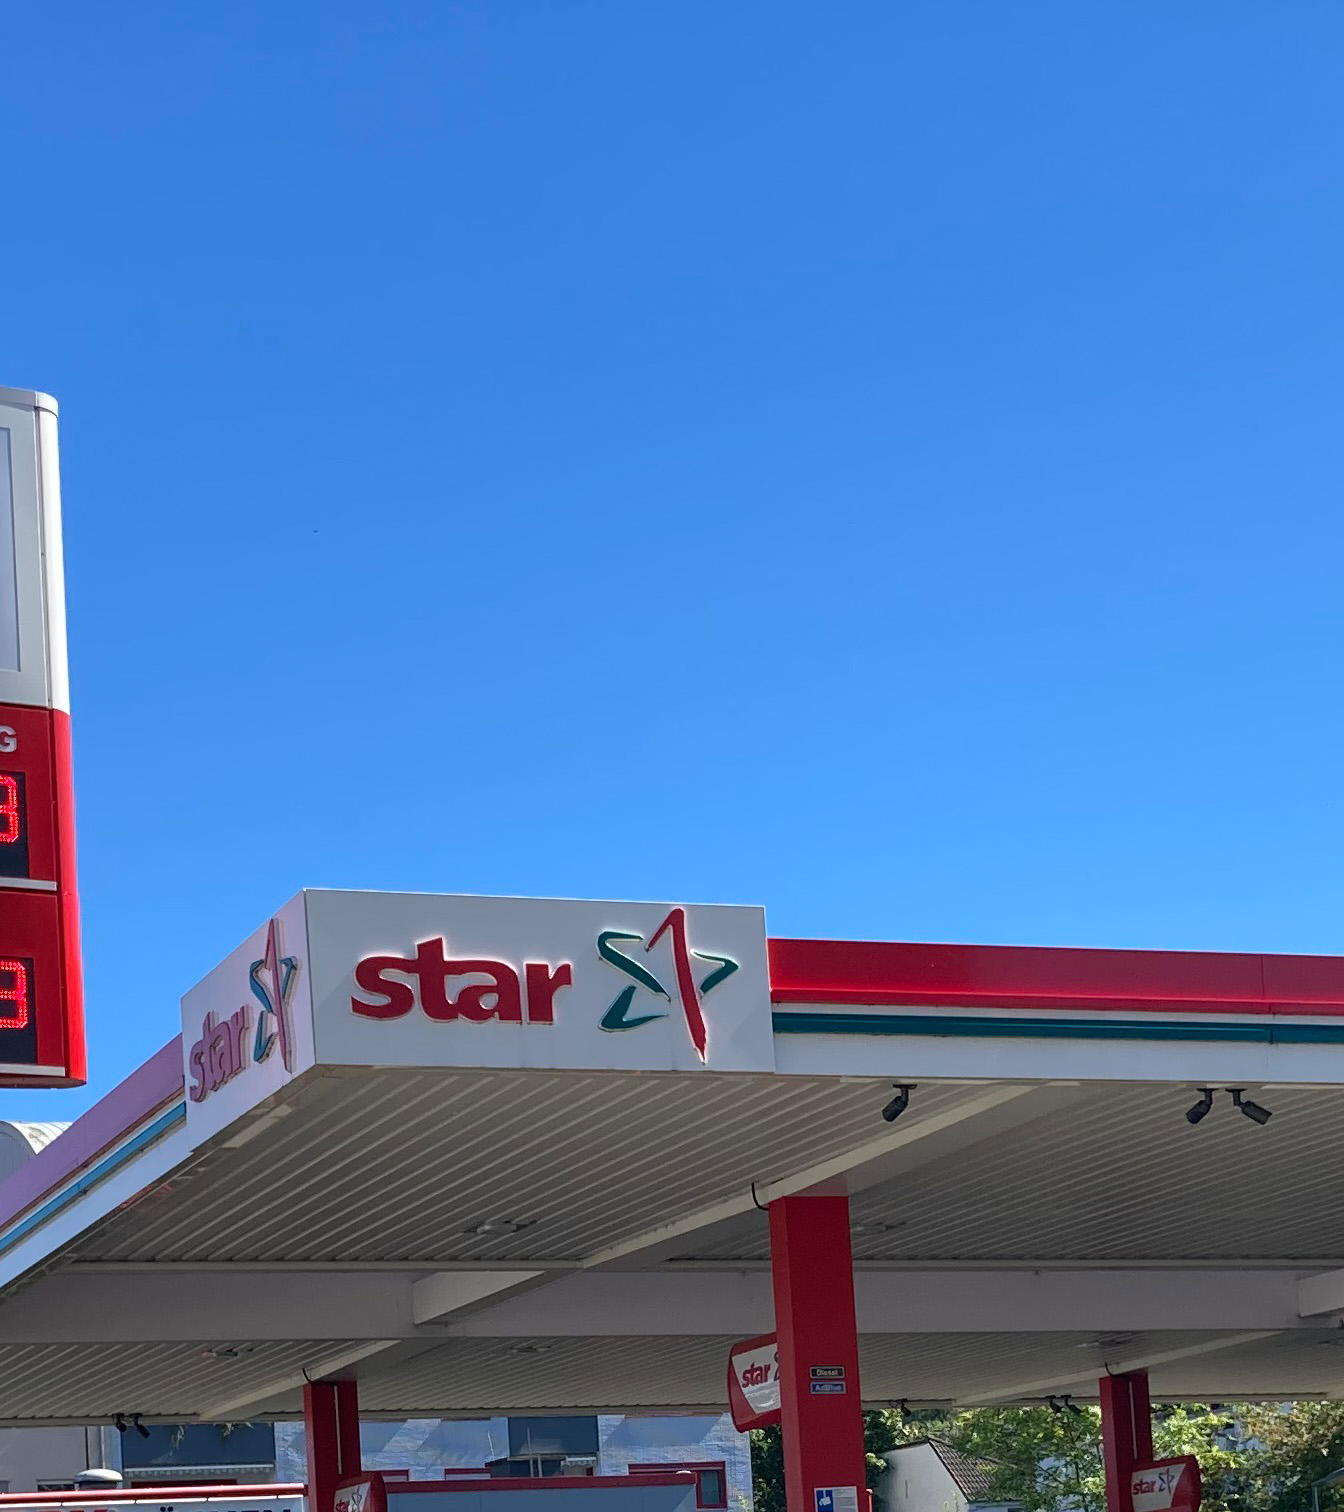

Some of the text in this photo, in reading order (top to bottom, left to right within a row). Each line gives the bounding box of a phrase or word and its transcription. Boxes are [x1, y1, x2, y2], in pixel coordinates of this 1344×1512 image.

[350, 935, 573, 1026] star
[188, 1004, 253, 1103] star
[742, 1361, 772, 1389] star
[1133, 1478, 1156, 1495] star
